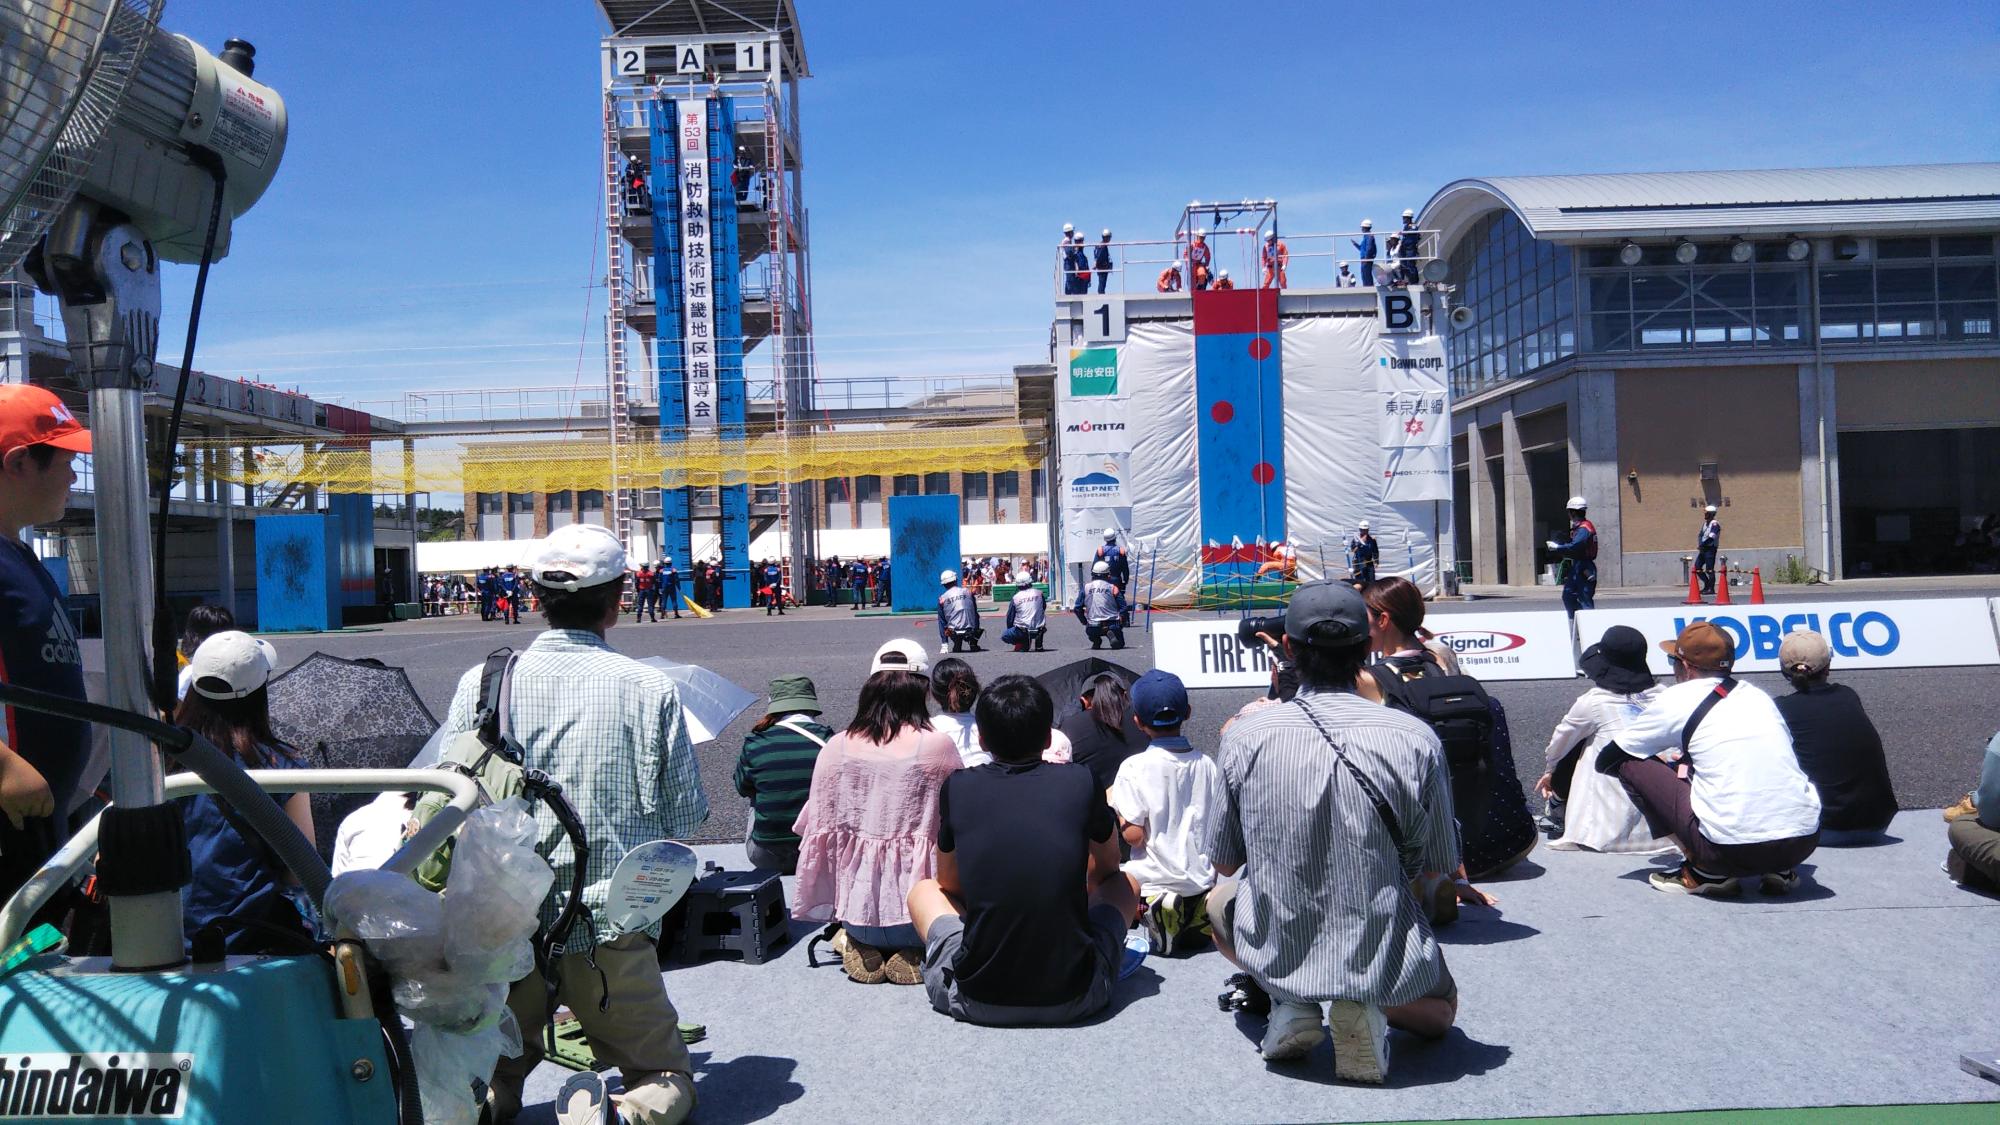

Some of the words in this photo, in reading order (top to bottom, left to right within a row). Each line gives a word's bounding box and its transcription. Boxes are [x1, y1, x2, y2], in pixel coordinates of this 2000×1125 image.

[623, 51, 639, 72] 2
[681, 48, 700, 70] A
[743, 46, 754, 68] 1
[685, 113, 701, 151] 第53回
[725, 214, 735, 224] 13
[726, 244, 736, 255] 12
[727, 274, 737, 284] 11
[686, 162, 711, 418] 消防救助技術近畿地区指導会
[659, 306, 669, 317] 10
[728, 304, 738, 314] 10
[1385, 295, 1414, 329] B
[1094, 304, 1110, 337] 1
[1390, 356, 1417, 370] Dawn
[1419, 356, 1444, 371] corp.
[1073, 366, 1115, 379] 明治安田
[247, 388, 254, 413] 3
[662, 395, 668, 408] 7
[735, 393, 741, 405] 7
[1066, 421, 1125, 433] MORITA
[1071, 485, 1120, 493] HELPNET
[666, 514, 673, 526] 3
[739, 513, 745, 523] 3
[667, 545, 674, 554] 2
[741, 543, 747, 554] 2
[1089, 587, 1109, 595] STAFF
[946, 594, 967, 605] STAFF
[1018, 596, 1039, 605] STAFF
[1440, 634, 1495, 653] Signal
[1200, 633, 1247, 673] FIRE
[1466, 656, 1491, 666] Signal
